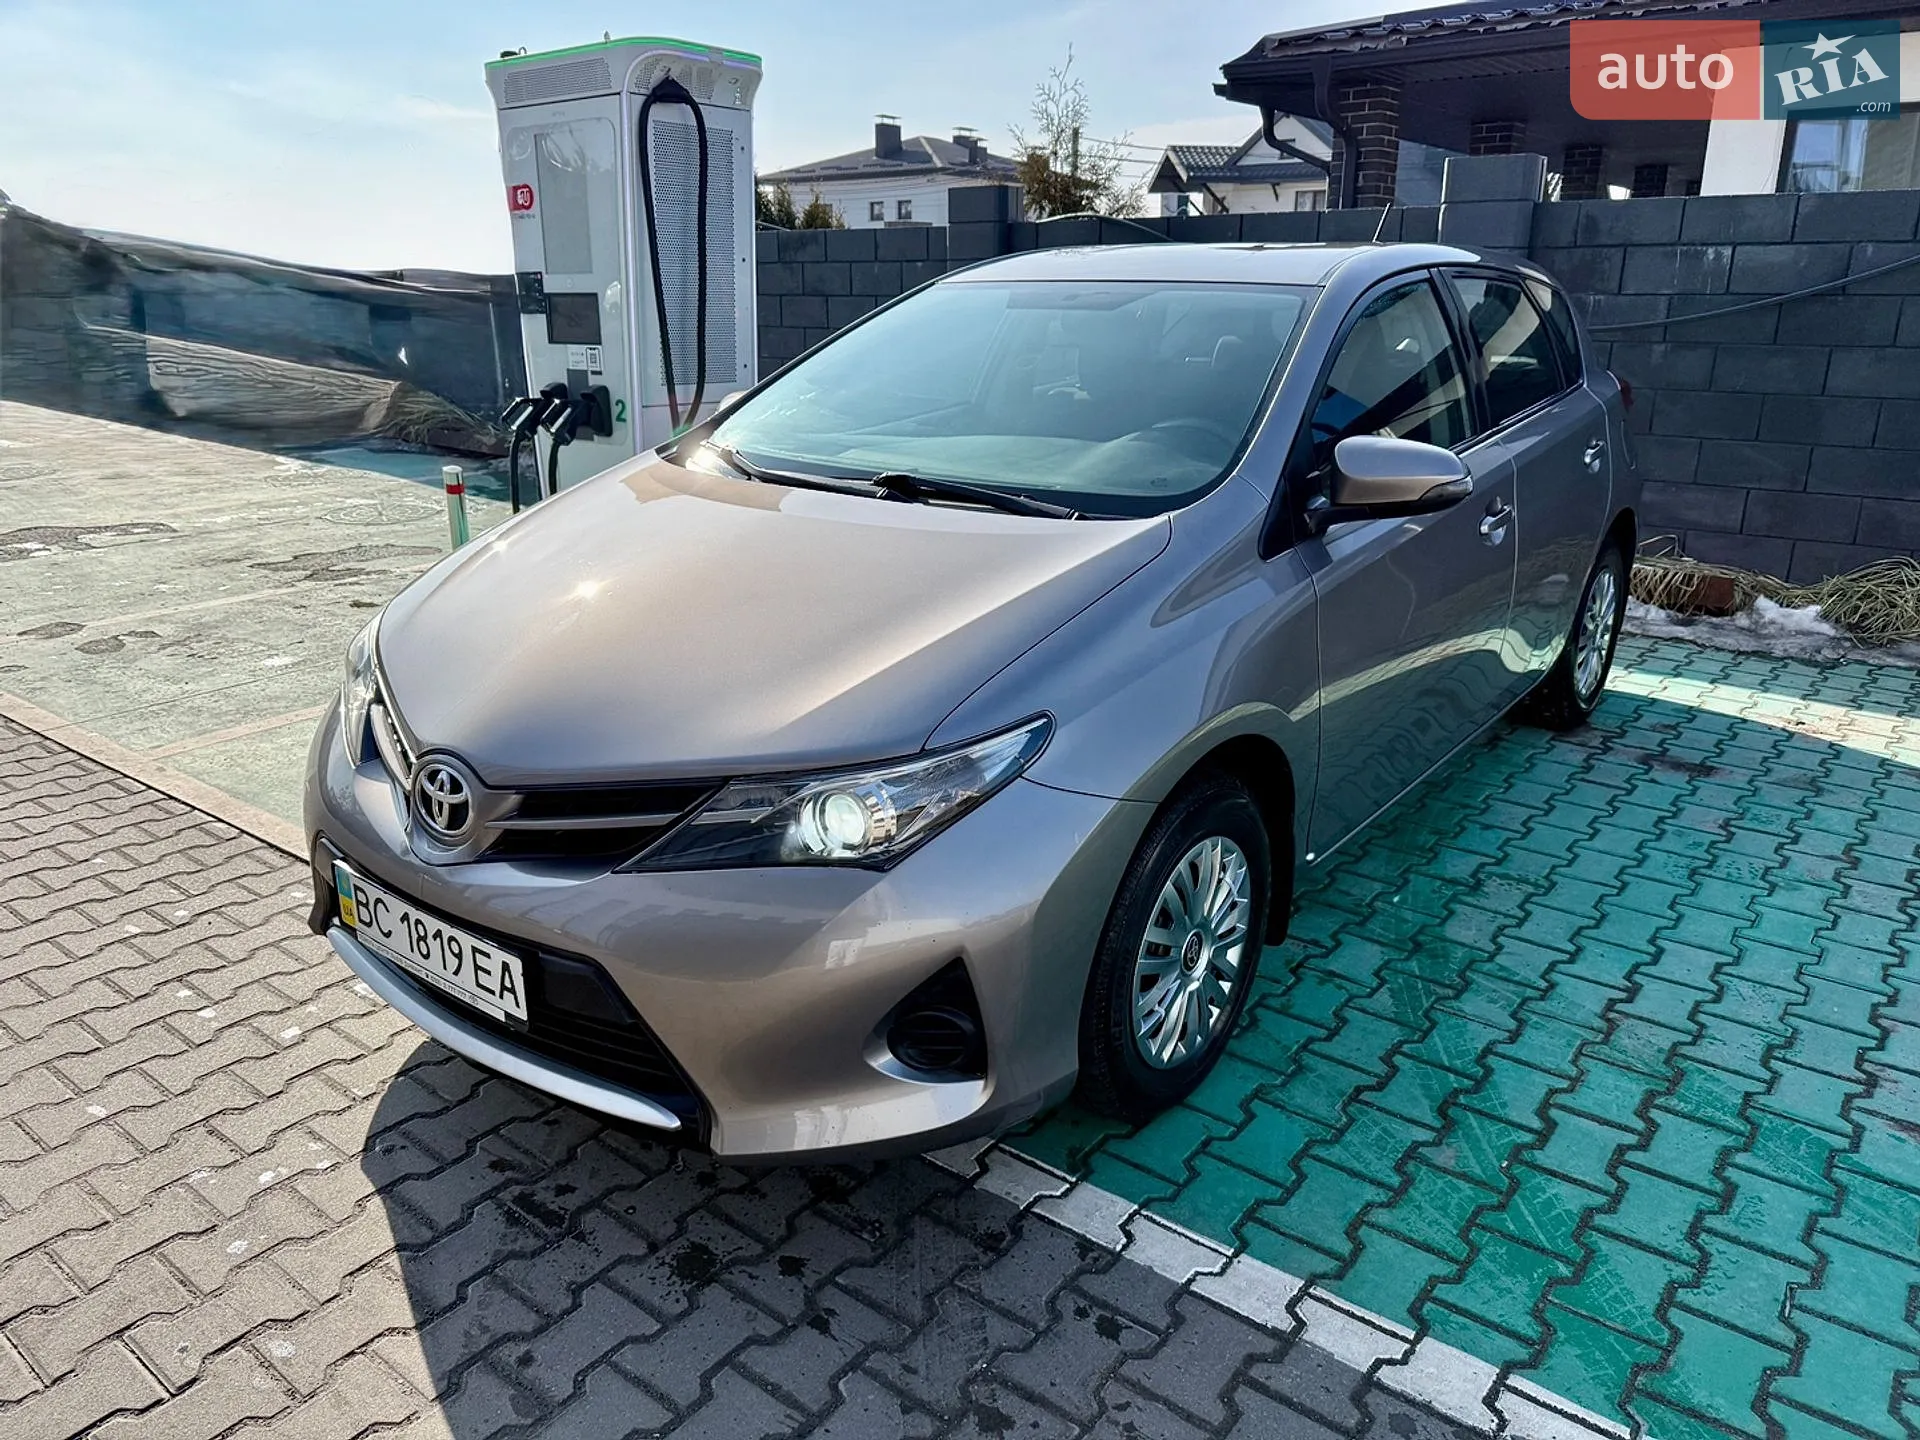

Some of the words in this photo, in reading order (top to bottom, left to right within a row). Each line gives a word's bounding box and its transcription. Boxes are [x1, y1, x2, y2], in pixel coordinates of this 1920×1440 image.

[615, 398, 627, 423] 2
[353, 883, 392, 939] BC
[400, 911, 464, 977] 1819
[471, 944, 521, 1010] EA
